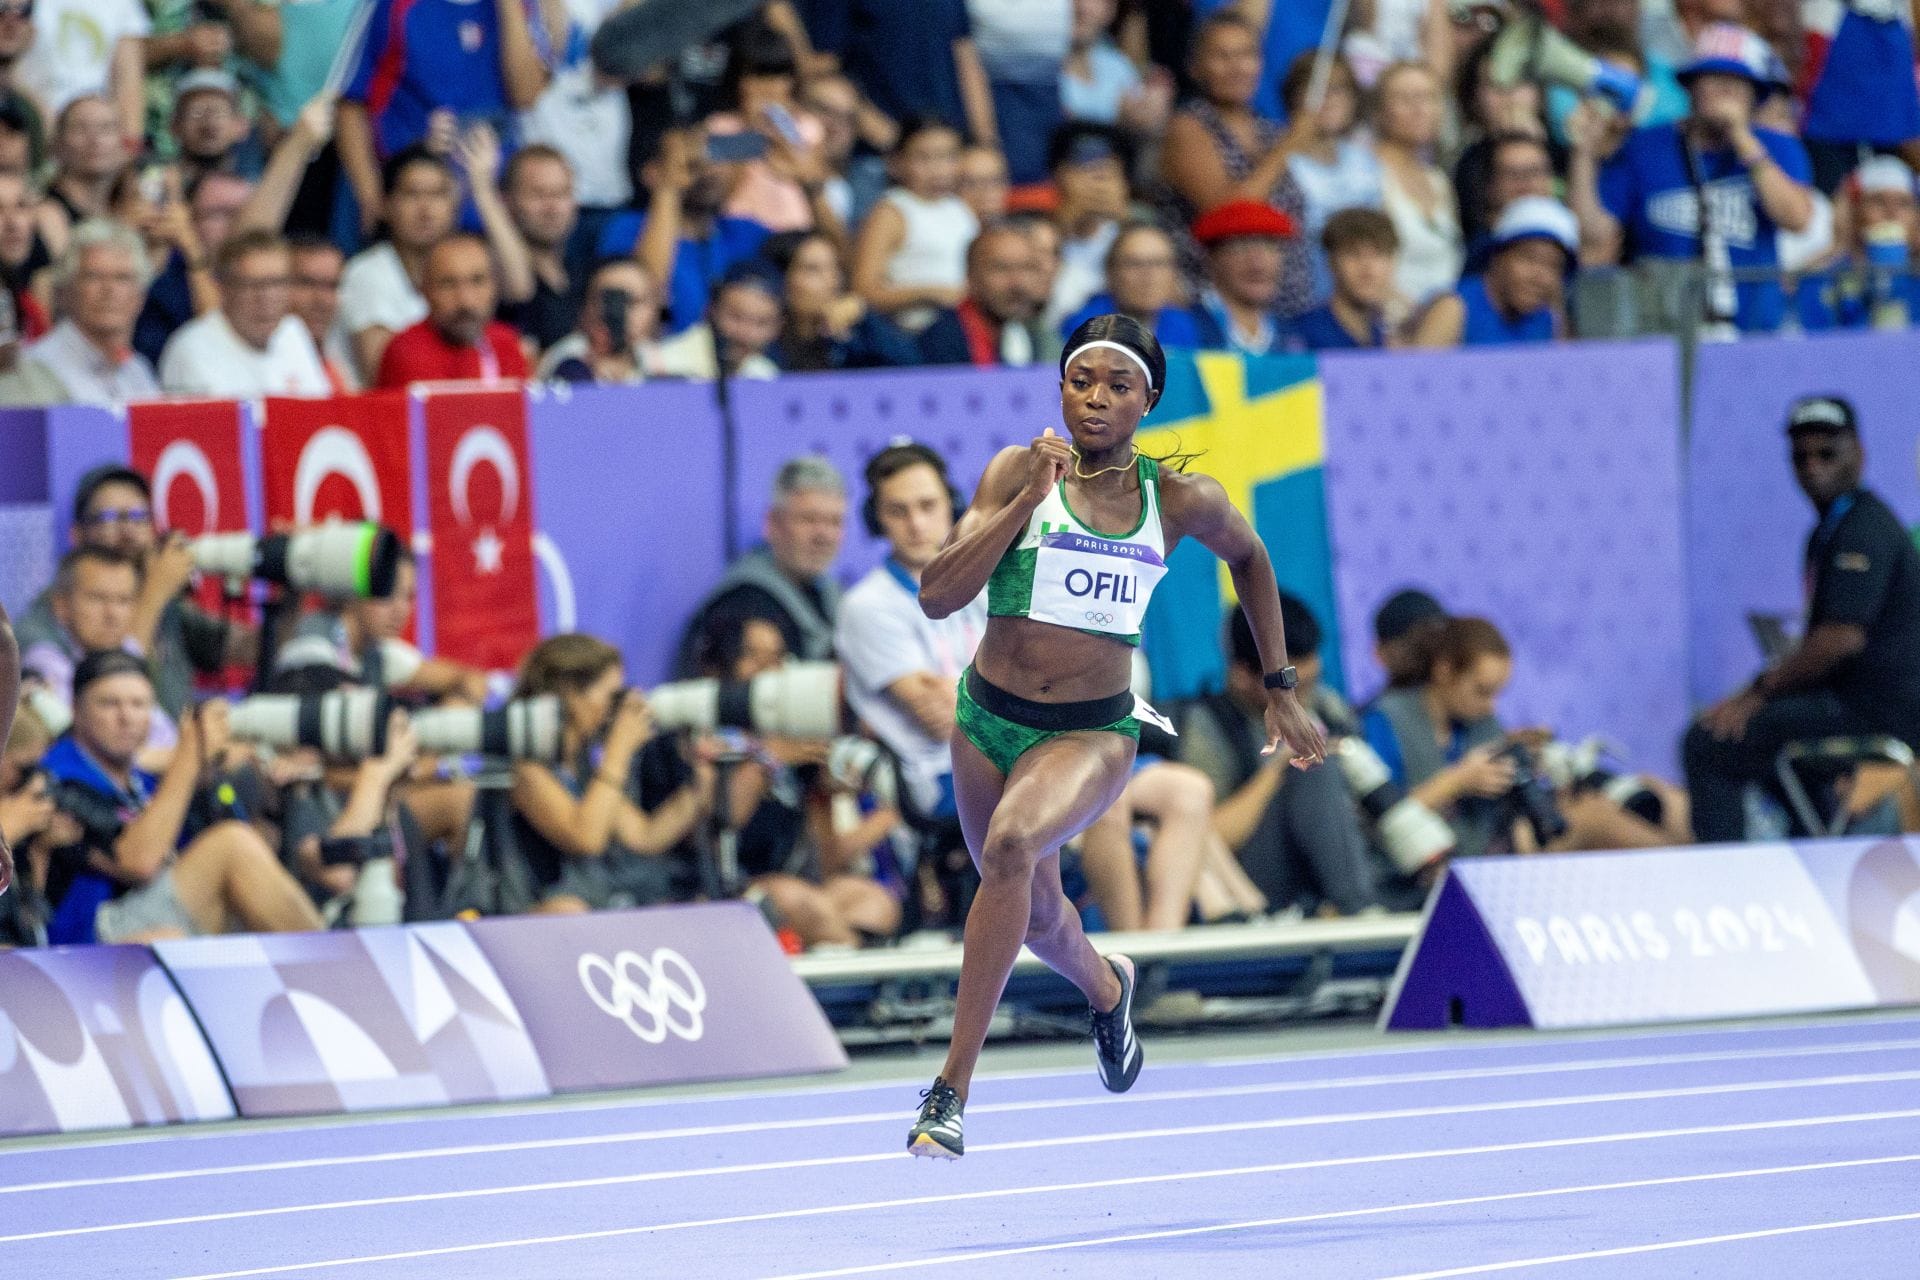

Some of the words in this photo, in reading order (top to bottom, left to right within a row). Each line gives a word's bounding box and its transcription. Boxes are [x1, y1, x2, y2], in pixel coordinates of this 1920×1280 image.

[1112, 545, 1143, 557] 2024
[1064, 568, 1137, 604] OFILI
[1515, 909, 1670, 966] PARIS
[1672, 901, 1816, 956] 2024
